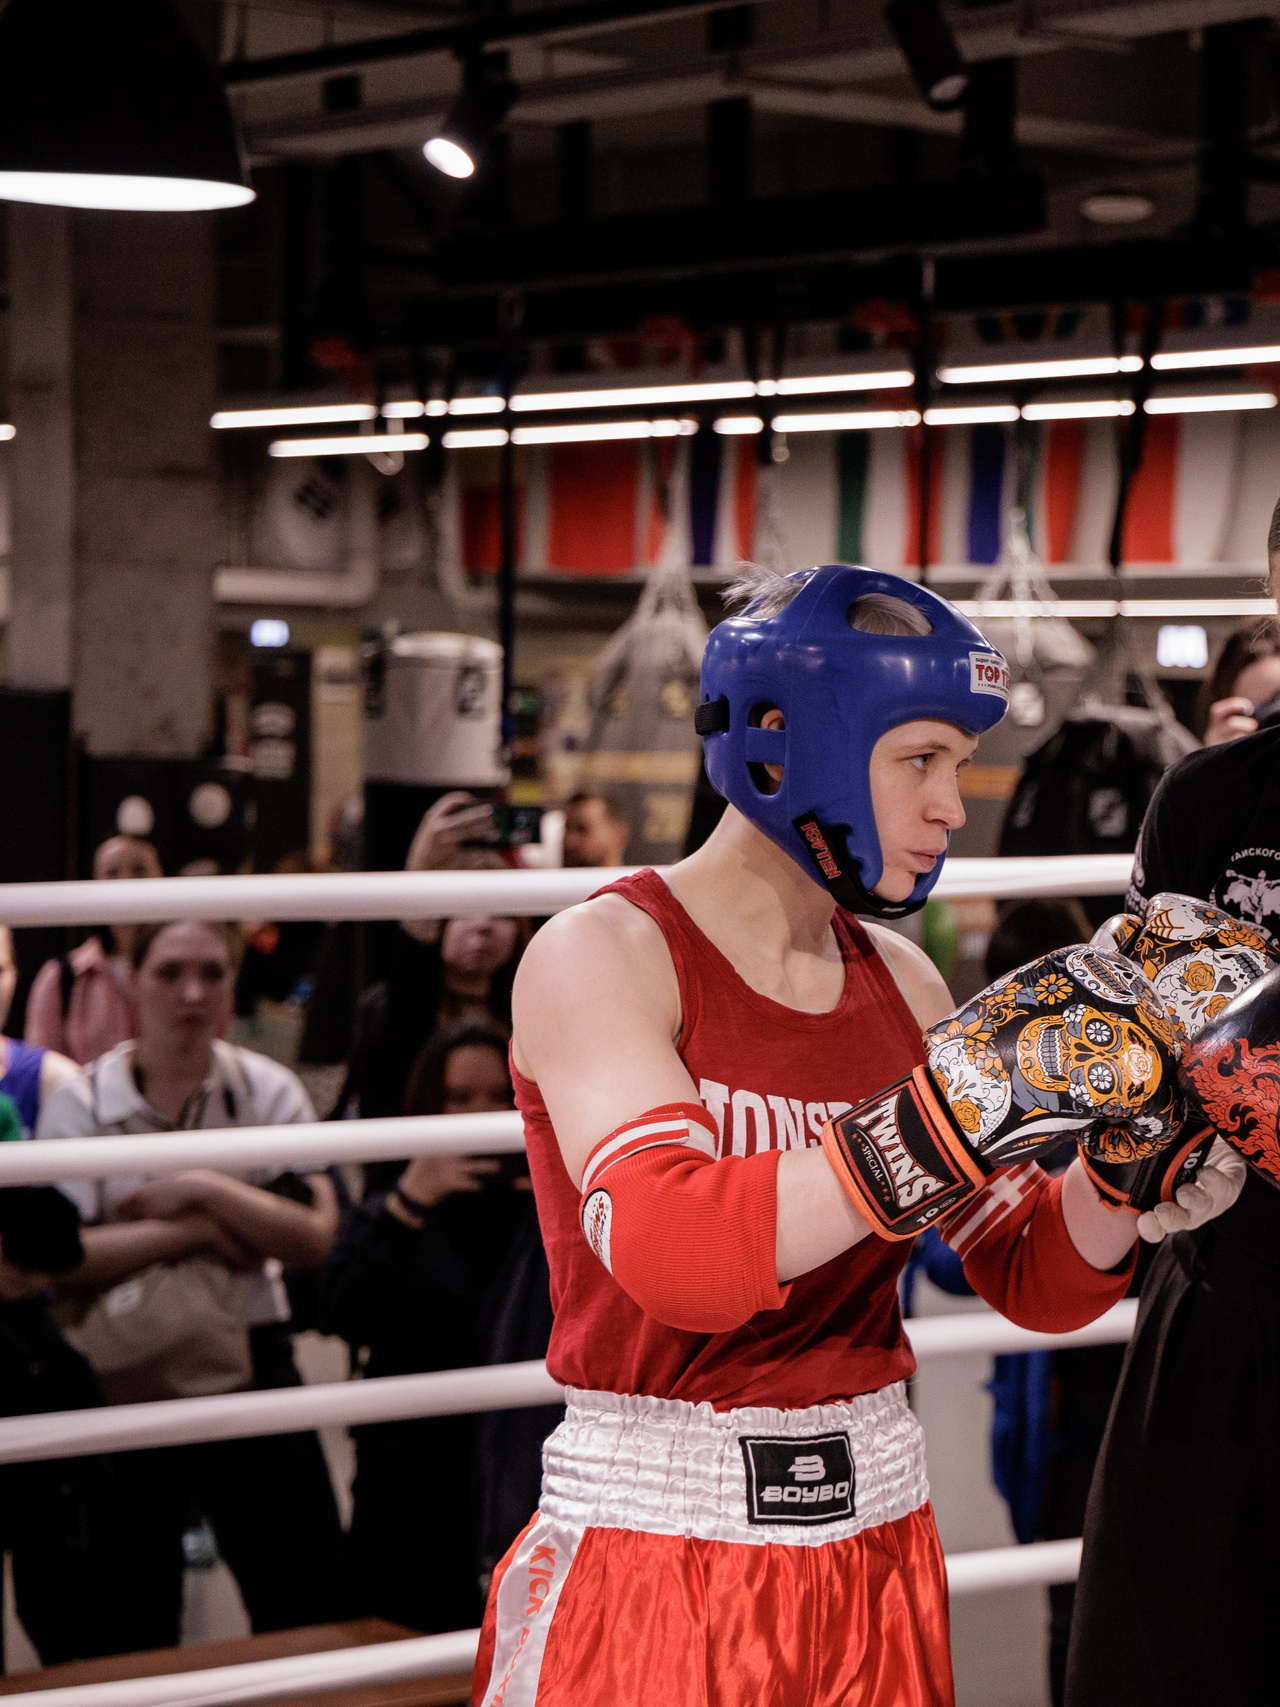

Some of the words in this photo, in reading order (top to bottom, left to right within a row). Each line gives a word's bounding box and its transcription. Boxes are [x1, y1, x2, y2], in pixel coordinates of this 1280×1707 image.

[975, 664, 1000, 683] TOP
[700, 1077, 867, 1162] TONS
[854, 1092, 948, 1209] TWINS
[861, 1145, 884, 1182] SPECIAL
[1183, 1150, 1203, 1169] 10
[917, 1207, 939, 1225] 10
[760, 1481, 850, 1503] BOYBO
[526, 1544, 557, 1617] KICK
